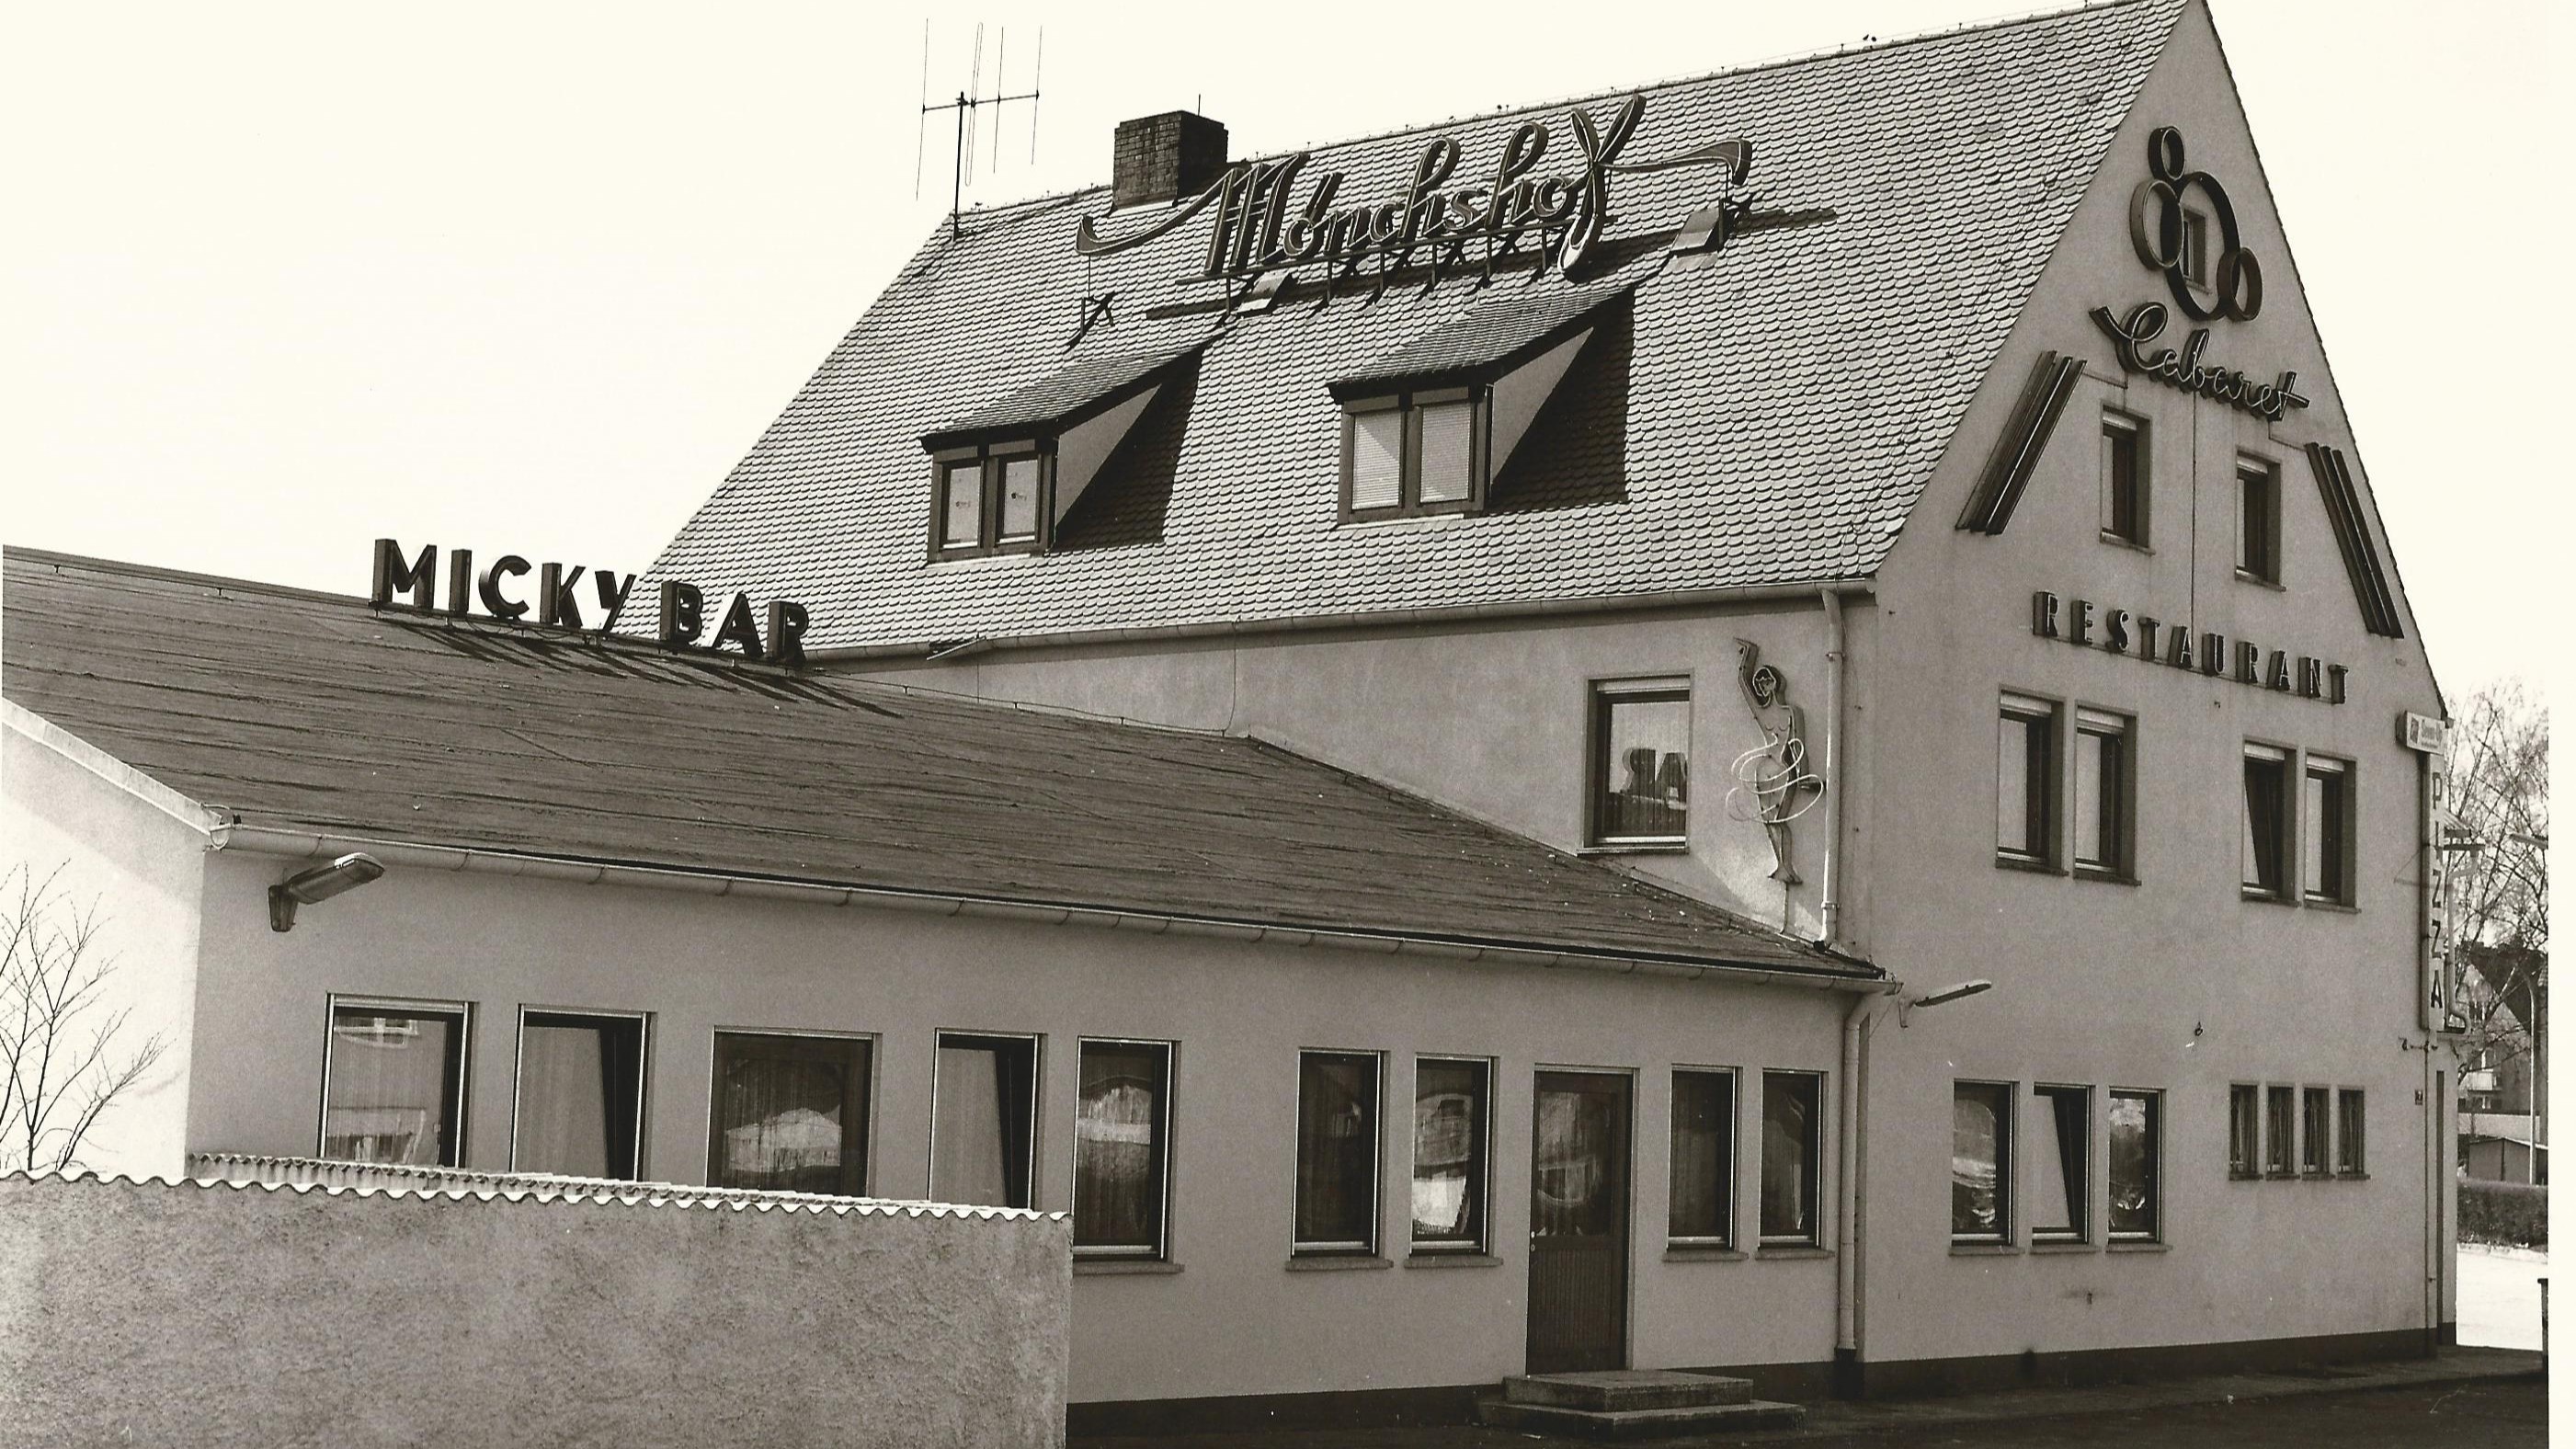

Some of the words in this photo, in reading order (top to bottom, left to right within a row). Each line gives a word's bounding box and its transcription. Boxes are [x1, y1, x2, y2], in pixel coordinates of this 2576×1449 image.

[1076, 94, 1753, 277] Mönchshof
[2089, 302, 2310, 421] Cabaret
[373, 538, 637, 634] MICKY
[660, 580, 810, 664] BAR
[2033, 590, 2349, 705] RESTAURANT
[2431, 771, 2444, 1010] PIZZA
